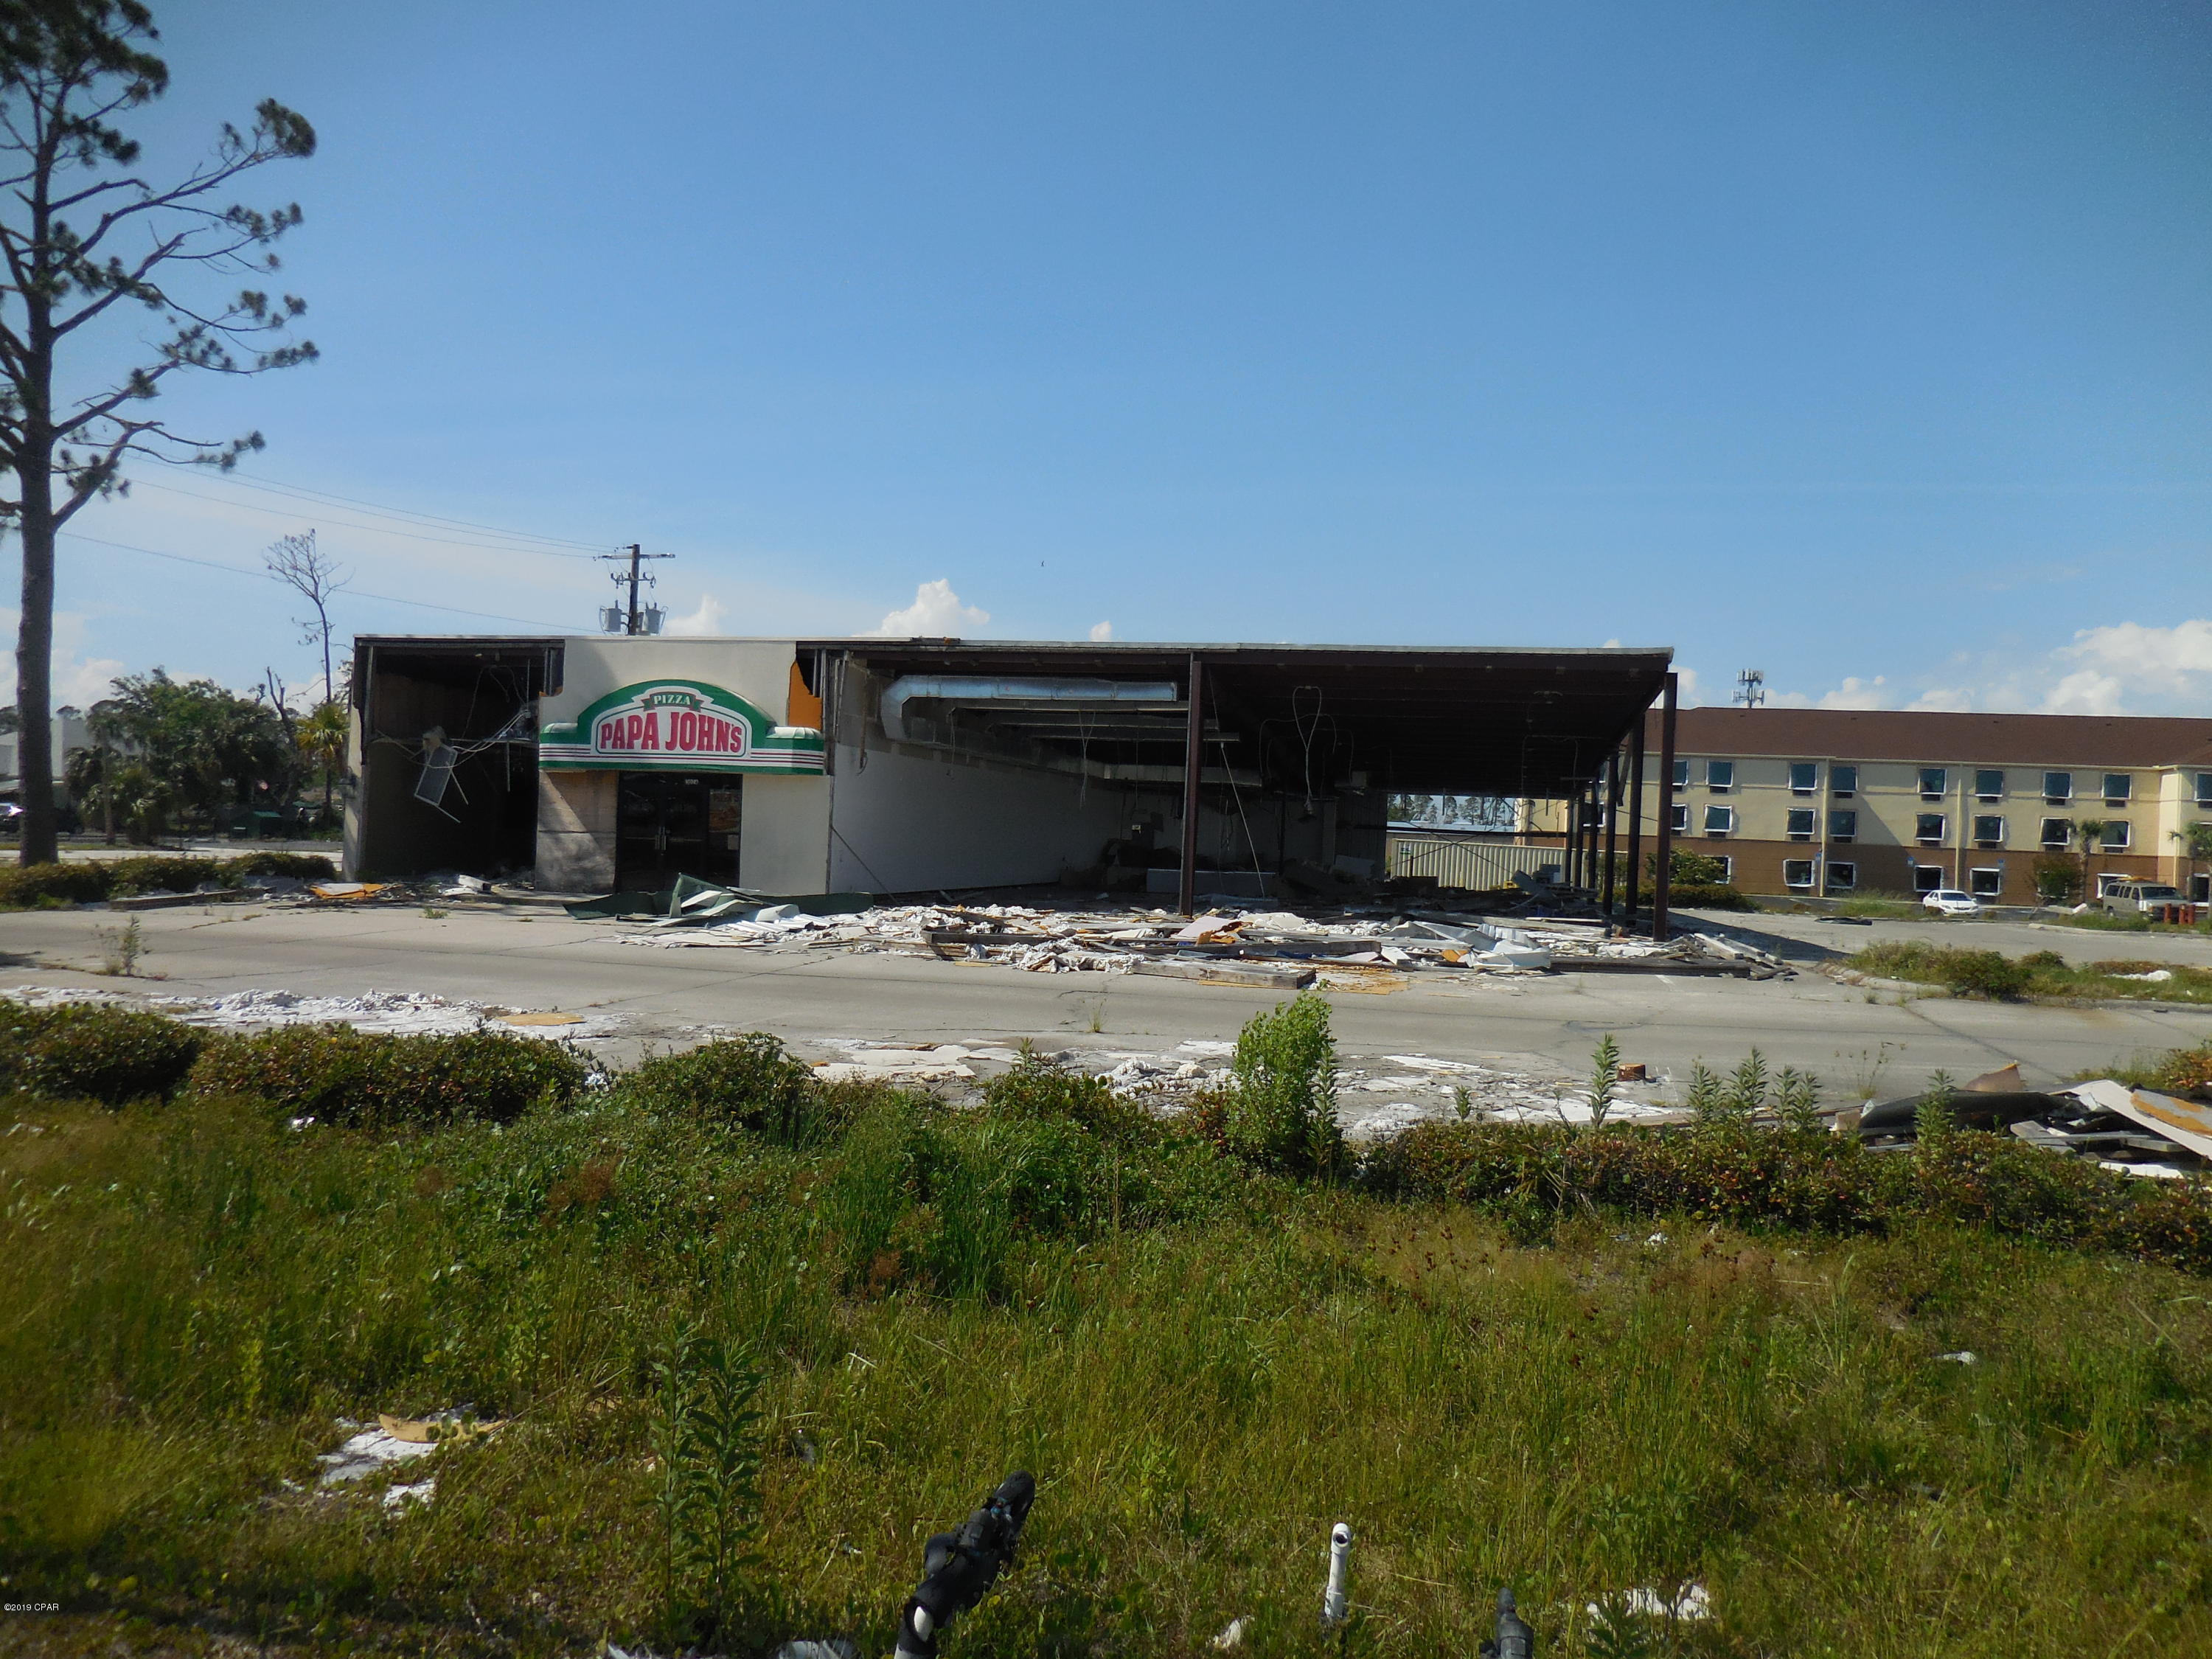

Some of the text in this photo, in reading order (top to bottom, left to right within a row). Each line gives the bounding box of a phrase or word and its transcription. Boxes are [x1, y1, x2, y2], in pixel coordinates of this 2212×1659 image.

[653, 695, 691, 705] PIZZA
[600, 712, 742, 753] PAPA JOHN'S
